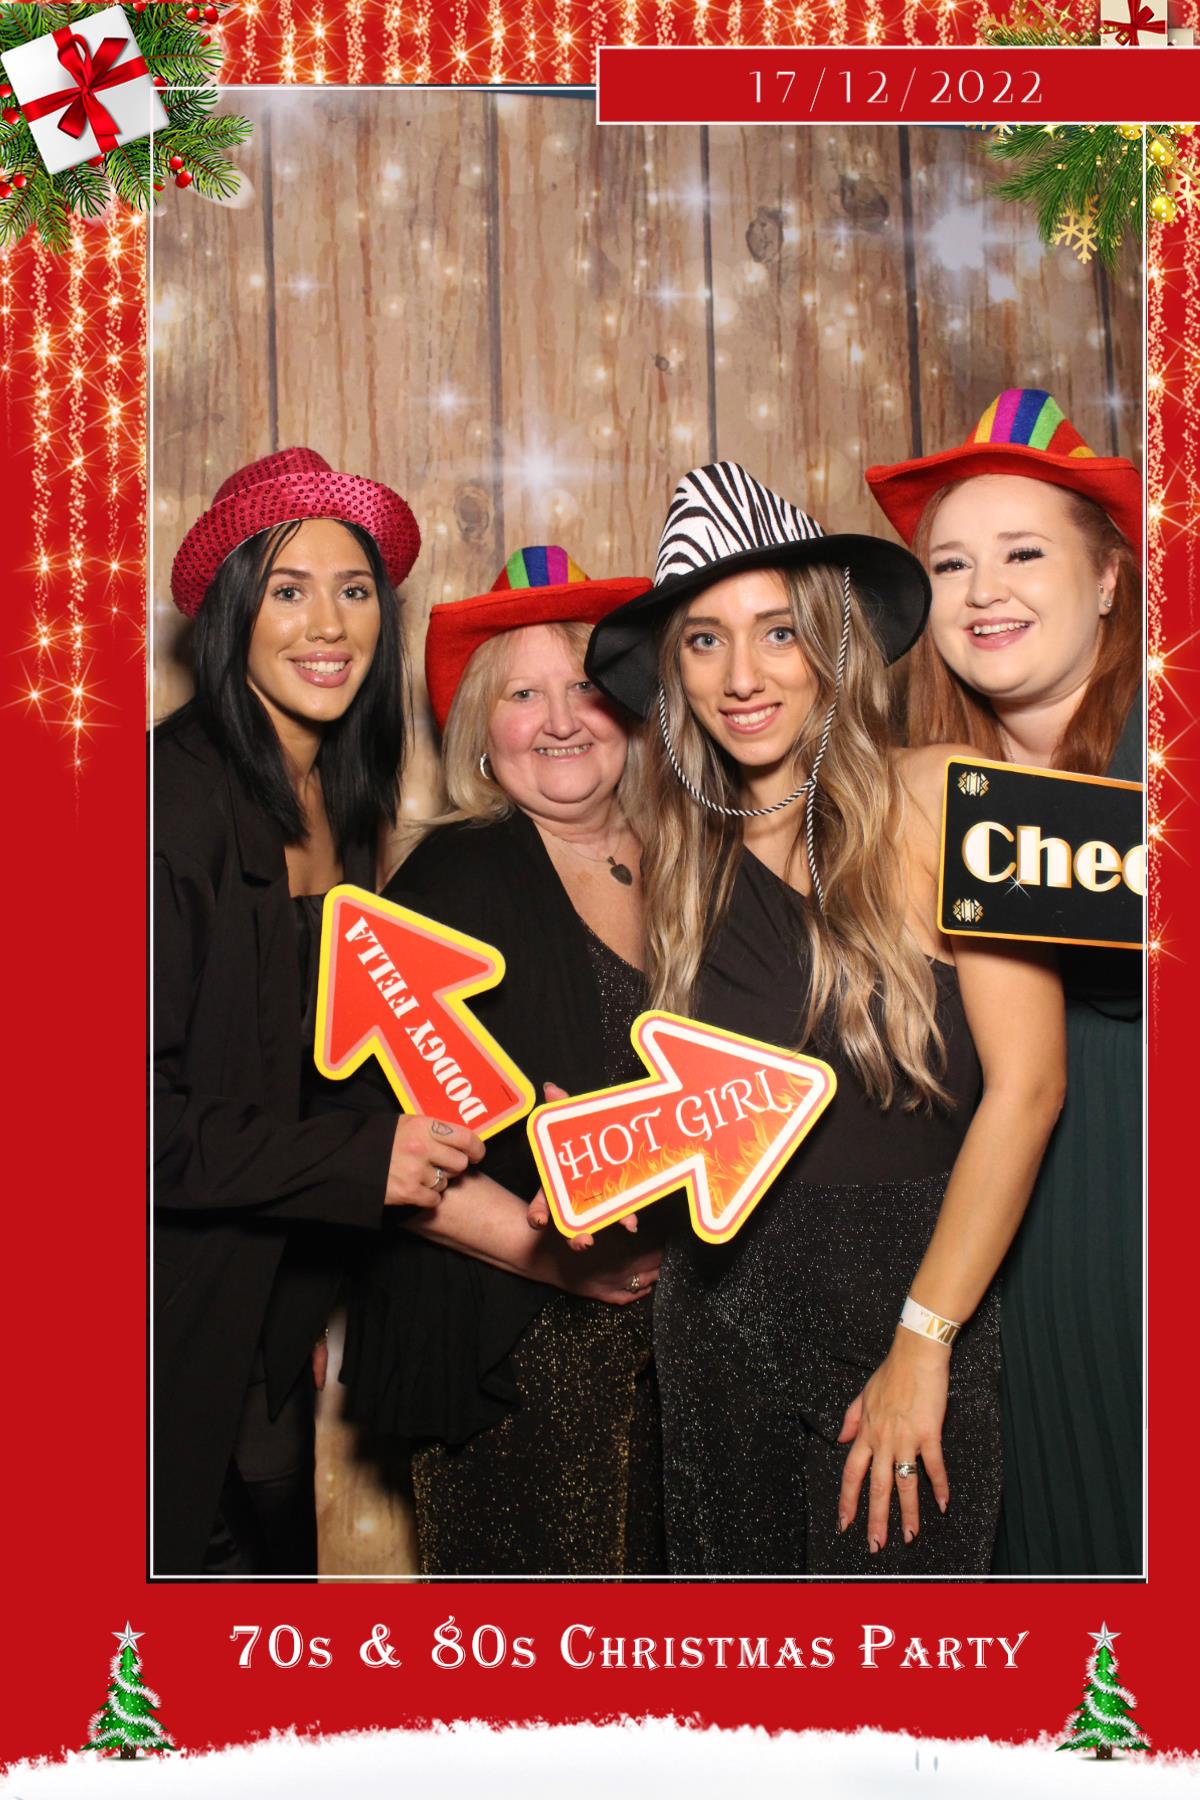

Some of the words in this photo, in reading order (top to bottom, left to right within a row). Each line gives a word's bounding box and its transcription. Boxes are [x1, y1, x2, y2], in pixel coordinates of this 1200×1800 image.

[344, 916, 420, 1020] FELLA
[404, 1018, 488, 1125] DODGY
[557, 1106, 662, 1182] HOT
[674, 1068, 794, 1142] GIRL
